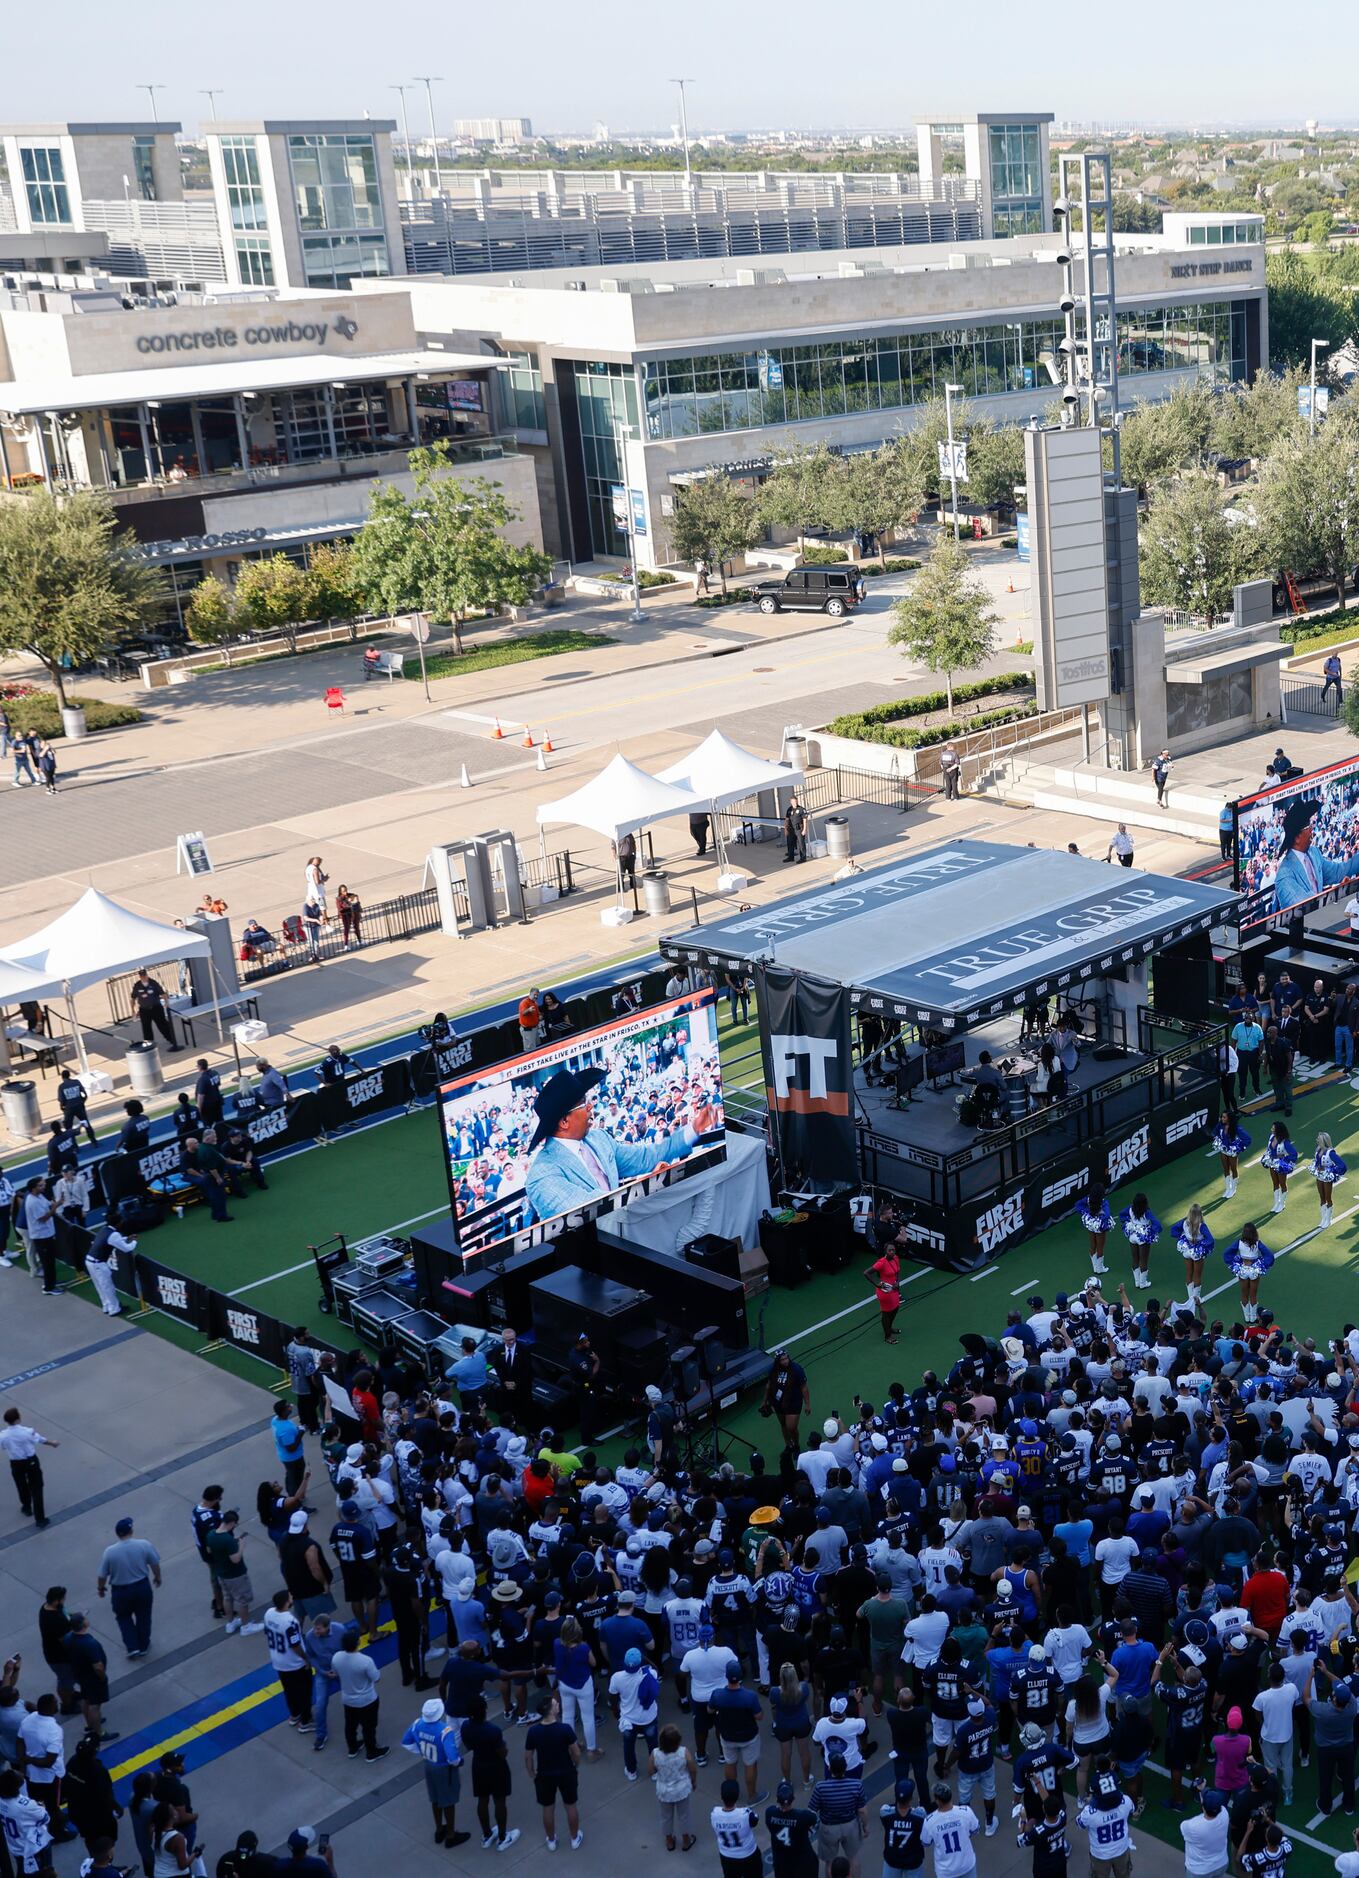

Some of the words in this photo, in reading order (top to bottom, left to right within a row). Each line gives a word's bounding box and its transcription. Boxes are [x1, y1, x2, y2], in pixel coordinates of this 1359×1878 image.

[136, 327, 238, 353] concrete
[244, 320, 328, 346] cowboy
[862, 856, 997, 896] TRUE
[754, 898, 865, 939] GRIP
[1072, 934, 1090, 944] &
[1093, 898, 1187, 934] Lighting
[915, 929, 1064, 983] TRUE
[1056, 889, 1165, 930] GRIP
[516, 1062, 535, 1074] FIRST
[537, 1056, 553, 1068] TAKE
[554, 1050, 569, 1062] LIVE
[579, 1042, 590, 1052] THE
[592, 1037, 608, 1048] STAR
[608, 1034, 616, 1042] IN
[617, 1026, 640, 1038] FRISCO,
[642, 1020, 650, 1028] TX
[770, 1034, 837, 1099] FT
[346, 1070, 384, 1098] FIRST
[350, 1084, 384, 1108] TAKE
[248, 1106, 287, 1134] FIRST
[1166, 1108, 1208, 1145] ESPN
[250, 1120, 289, 1144] TAKE
[1108, 1124, 1150, 1168] FIRST
[138, 1141, 180, 1172] FIRST
[1108, 1146, 1150, 1184] TAKE
[142, 1154, 181, 1183] TAKE
[1041, 1166, 1089, 1208] ESPN
[514, 1200, 604, 1254] FIRST
[613, 1164, 686, 1210] TAKE
[976, 1188, 1024, 1237] FIRST
[977, 1209, 1024, 1254] TAKE
[158, 1275, 187, 1295] FIRST
[160, 1291, 188, 1310] TAKE
[226, 1310, 257, 1329] FIRST
[231, 1327, 260, 1344] TAKE
[1152, 1448, 1173, 1456] PRESCOTT
[1022, 1459, 1041, 1476] 30
[1059, 1460, 1081, 1473] PRESCOTT
[1158, 1456, 1168, 1472] 4
[1066, 1469, 1076, 1484] 4
[1102, 1475, 1126, 1494] 88
[1304, 1471, 1314, 1486] 2
[338, 1540, 356, 1561] 21
[1330, 1556, 1343, 1564] LAMB
[933, 1567, 942, 1584] 1
[714, 1584, 738, 1593] PRESCOTT
[724, 1594, 740, 1612] 4
[676, 1610, 690, 1618] IRVIN
[994, 1608, 1020, 1618] PRESCOTT
[1224, 1617, 1239, 1626] IRVIN
[674, 1622, 698, 1640] 88
[266, 1633, 286, 1652] 88
[938, 1672, 958, 1680] ELLIOTT
[1027, 1679, 1048, 1688] ELLIOTT
[936, 1682, 958, 1700] 21
[1026, 1689, 1049, 1708] 21
[968, 1726, 995, 1743] PARSONS
[418, 1741, 438, 1761] 10
[968, 1740, 990, 1759] 11
[1098, 1776, 1116, 1794] 21
[716, 1822, 742, 1830] PARSONS
[770, 1816, 798, 1828] PRESCOTT
[893, 1820, 912, 1830] DESAI
[936, 1820, 962, 1832] PARSONS
[1103, 1812, 1118, 1824] LAMB
[719, 1831, 740, 1848] 11
[776, 1826, 792, 1846] 4
[889, 1830, 912, 1848] 17
[1096, 1820, 1125, 1844] 88
[942, 1831, 962, 1854] 11
